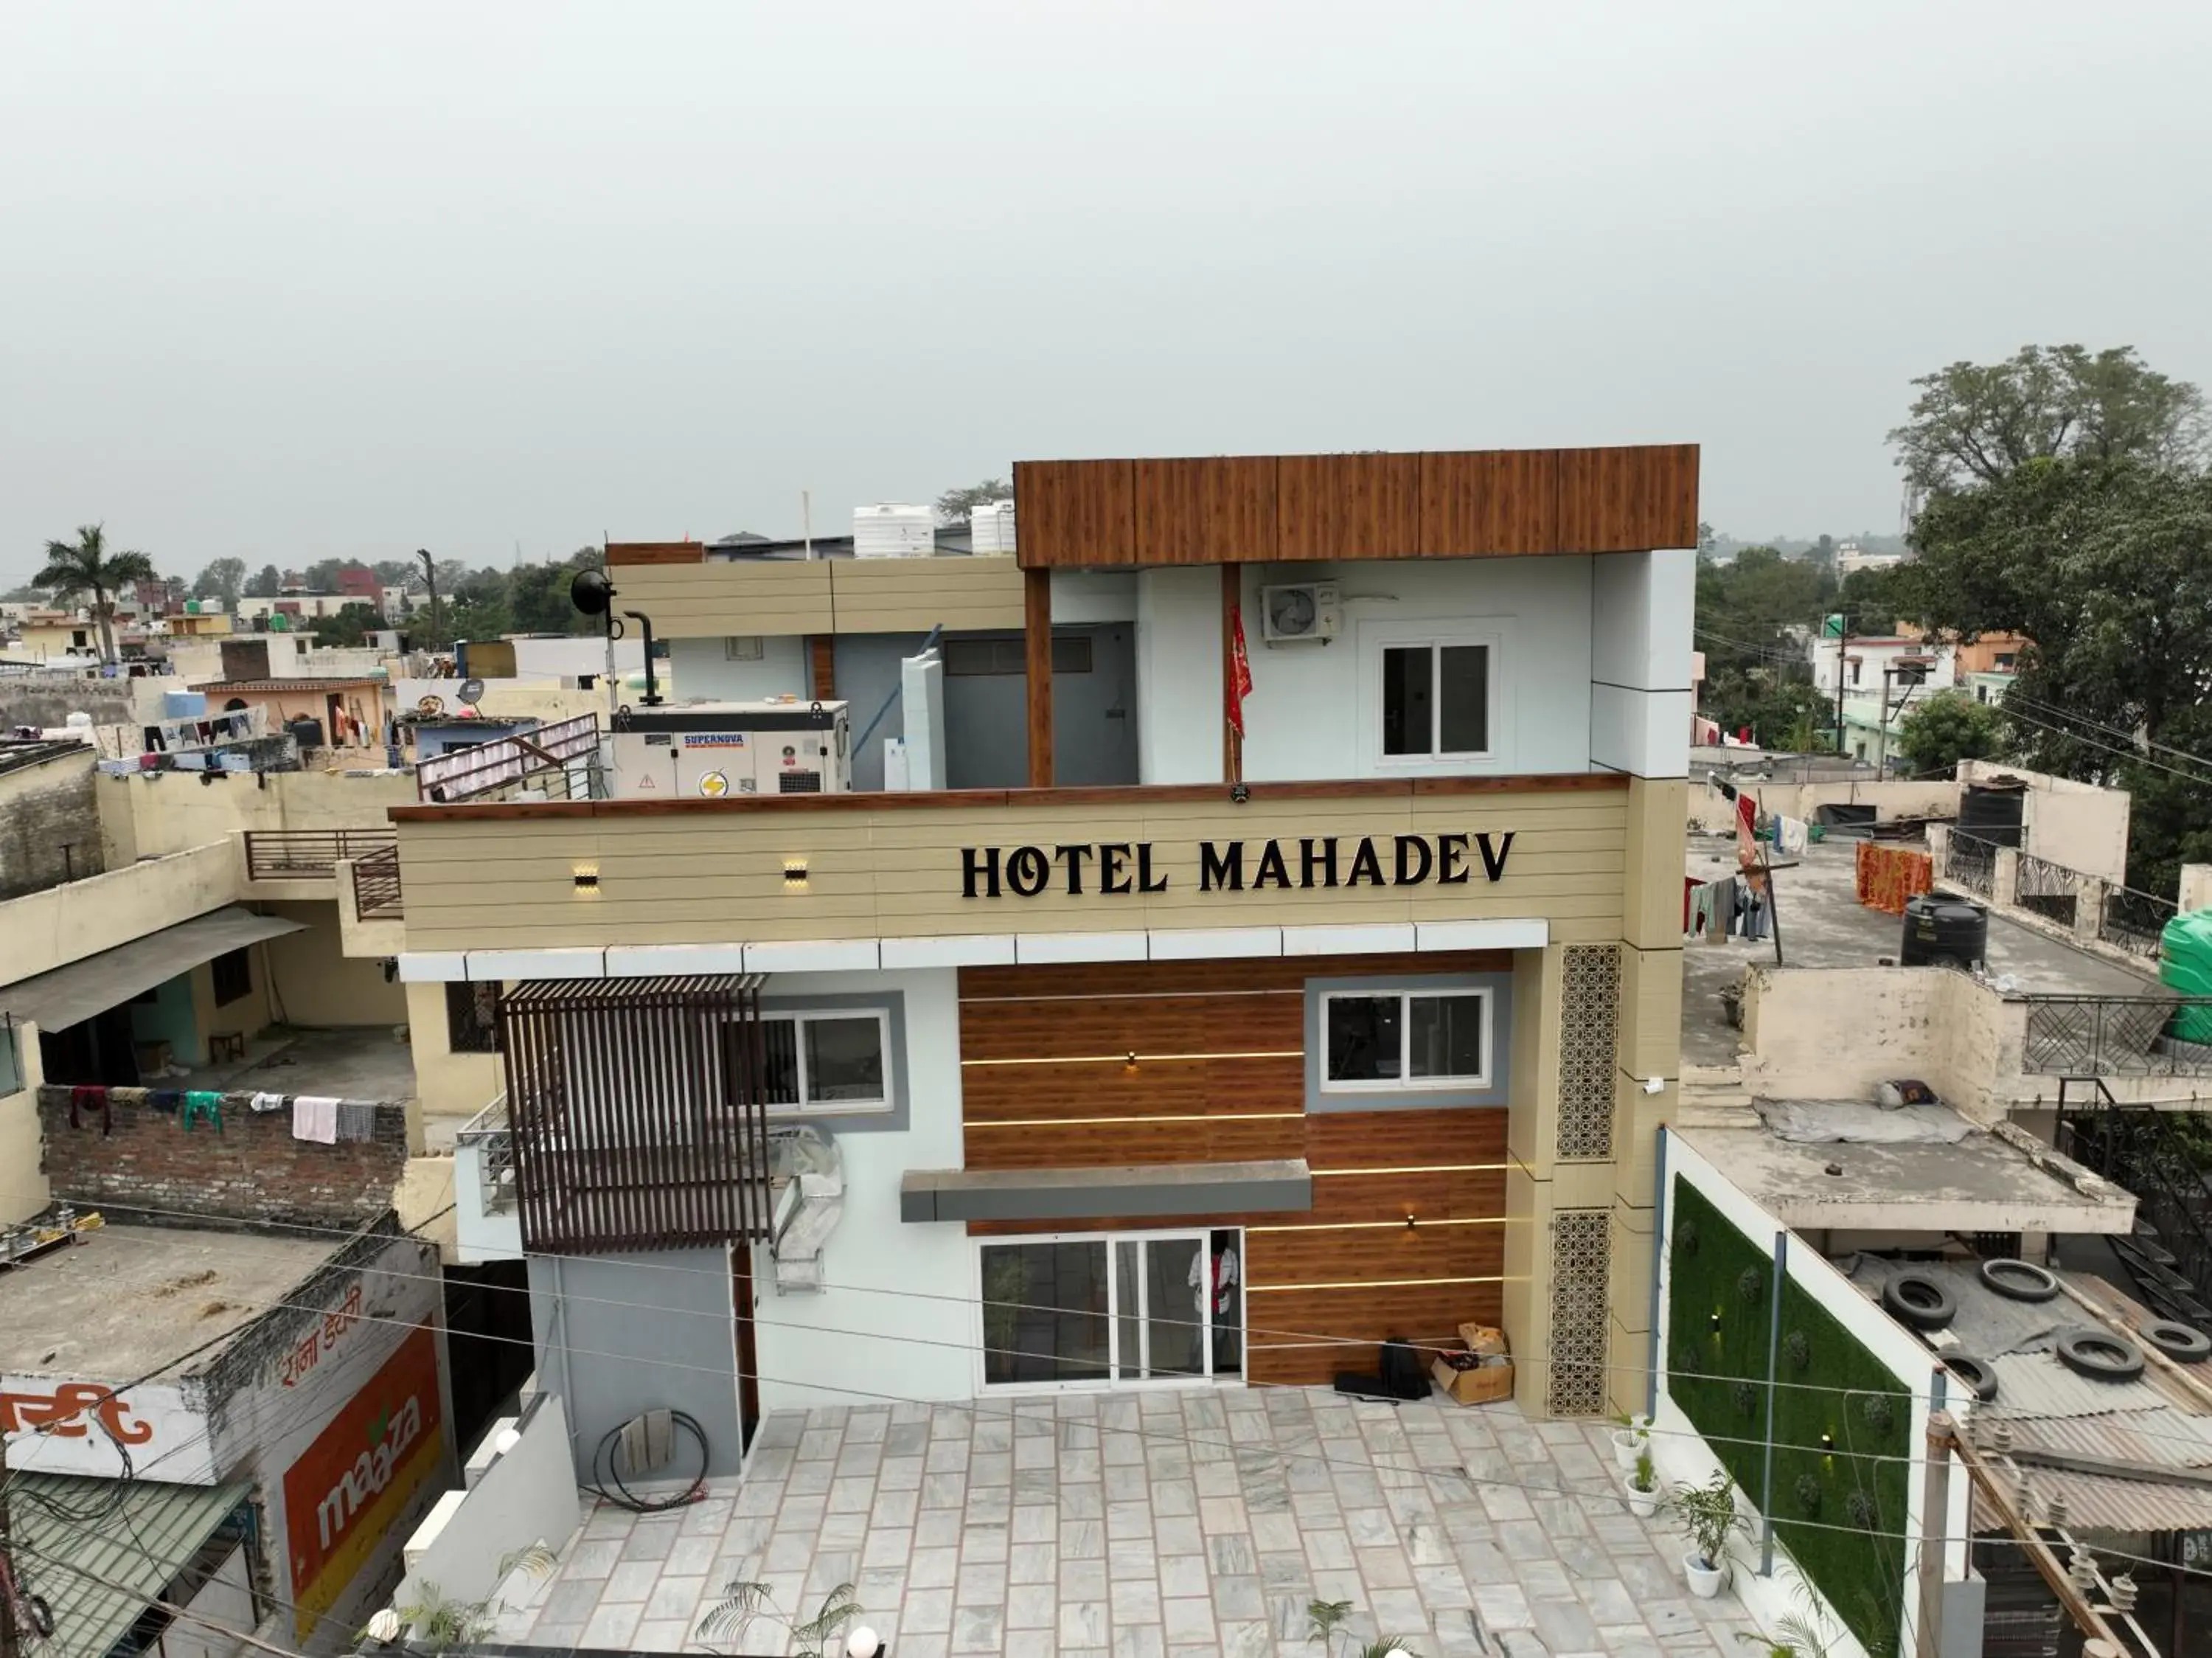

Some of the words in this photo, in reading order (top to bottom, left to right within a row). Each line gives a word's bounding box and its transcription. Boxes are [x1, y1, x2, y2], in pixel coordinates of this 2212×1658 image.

[684, 735, 744, 744] SUPERNOVA
[961, 842, 1169, 898] HOTEL
[1200, 831, 1516, 891] MAHADEV
[317, 1395, 421, 1550] maaza
